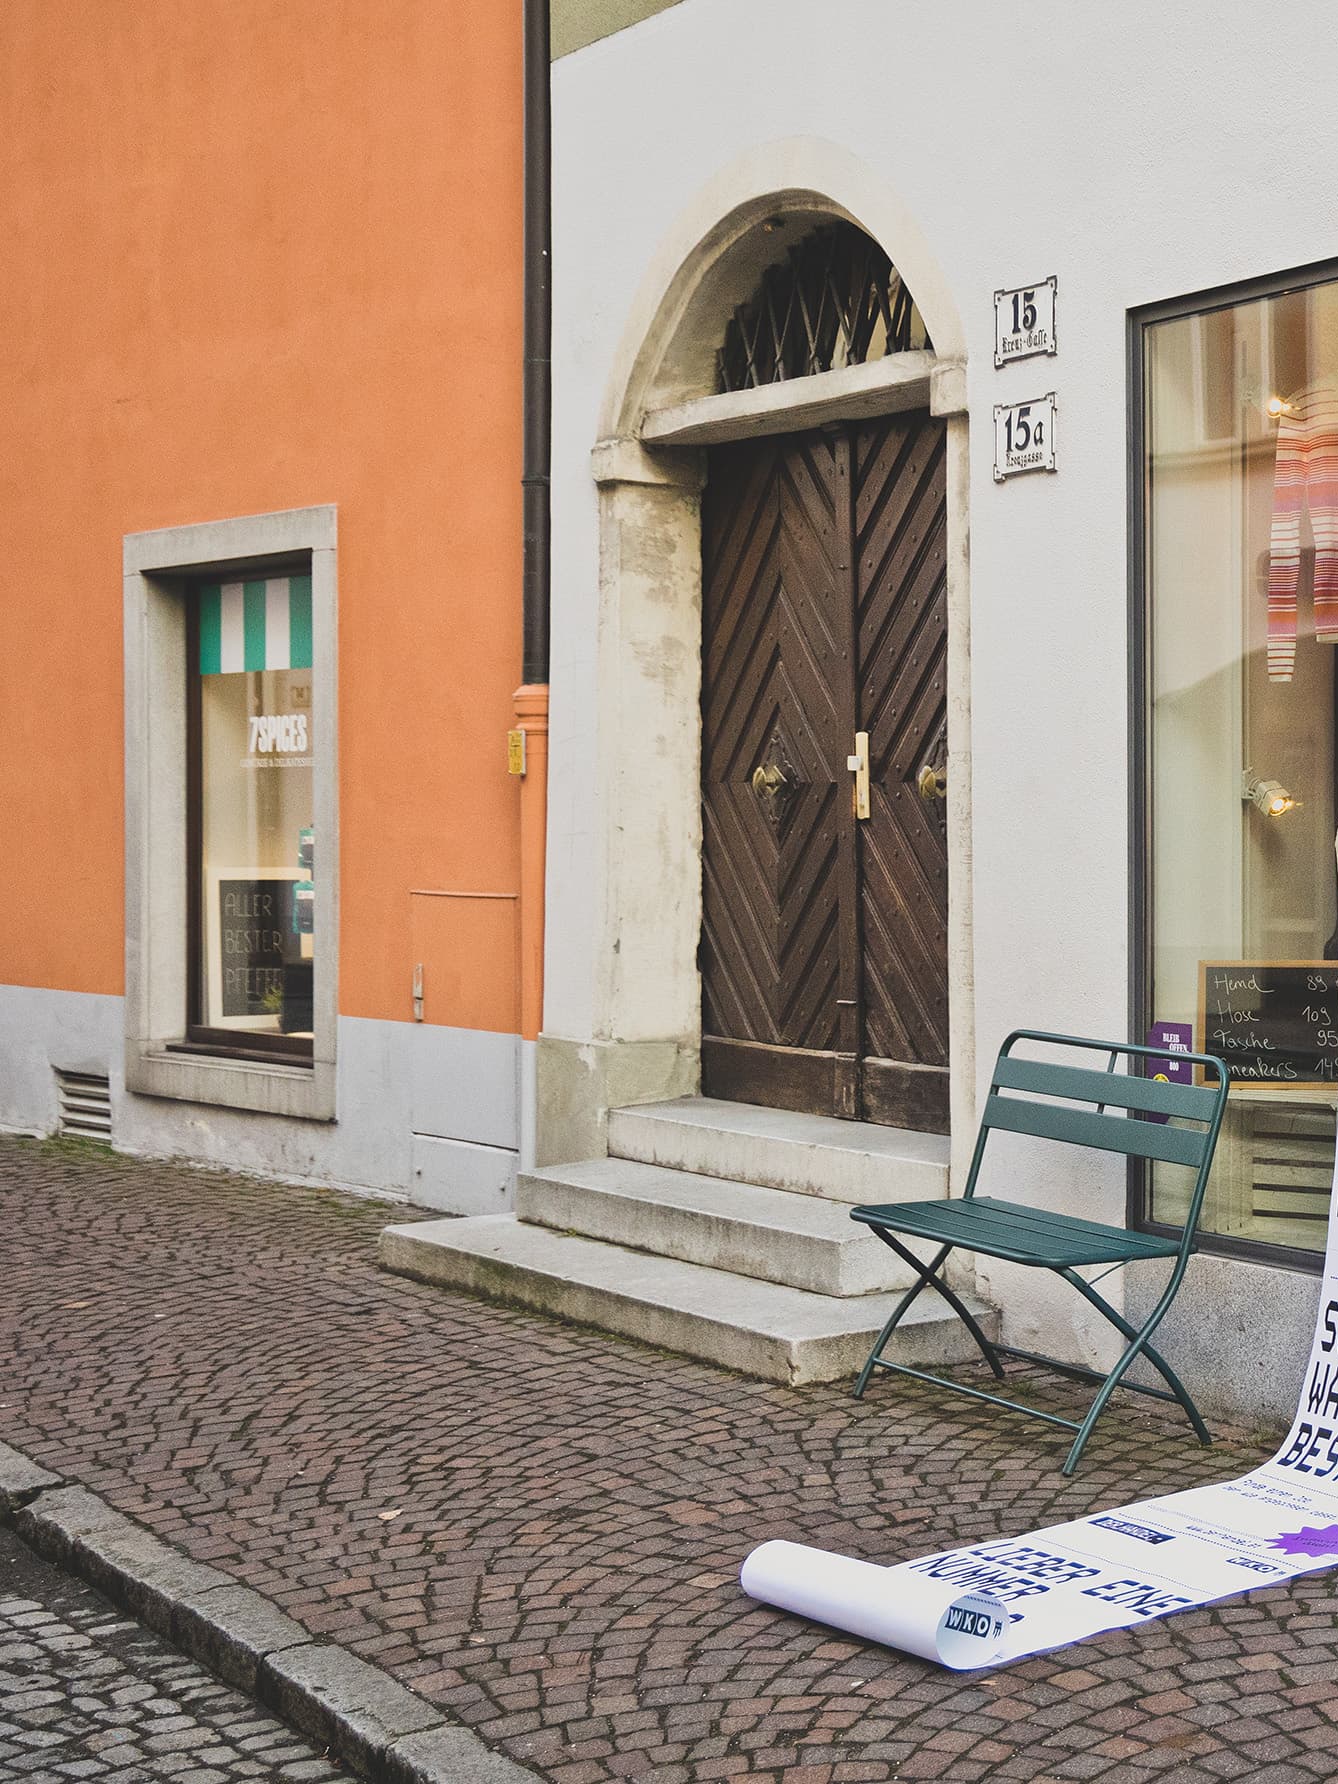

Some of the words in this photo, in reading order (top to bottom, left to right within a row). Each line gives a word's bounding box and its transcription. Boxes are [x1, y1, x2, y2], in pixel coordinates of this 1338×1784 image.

[1012, 289, 1037, 334] 15
[249, 714, 307, 753] 7SPICES
[224, 892, 273, 918] ALLER
[225, 929, 284, 954] BESTER
[1307, 975, 1328, 993] 89
[1217, 1000, 1260, 1024] Hose
[1302, 1005, 1332, 1026] 109
[1162, 1033, 1180, 1043] BLEIB
[1213, 1029, 1276, 1052] Tasche
[908, 1553, 1050, 1601] NUMMER
[1230, 1557, 1277, 1573] WKO
[968, 1542, 1101, 1584] LIEBER
[1080, 1579, 1193, 1616] EINE
[944, 1605, 991, 1638] WKO
